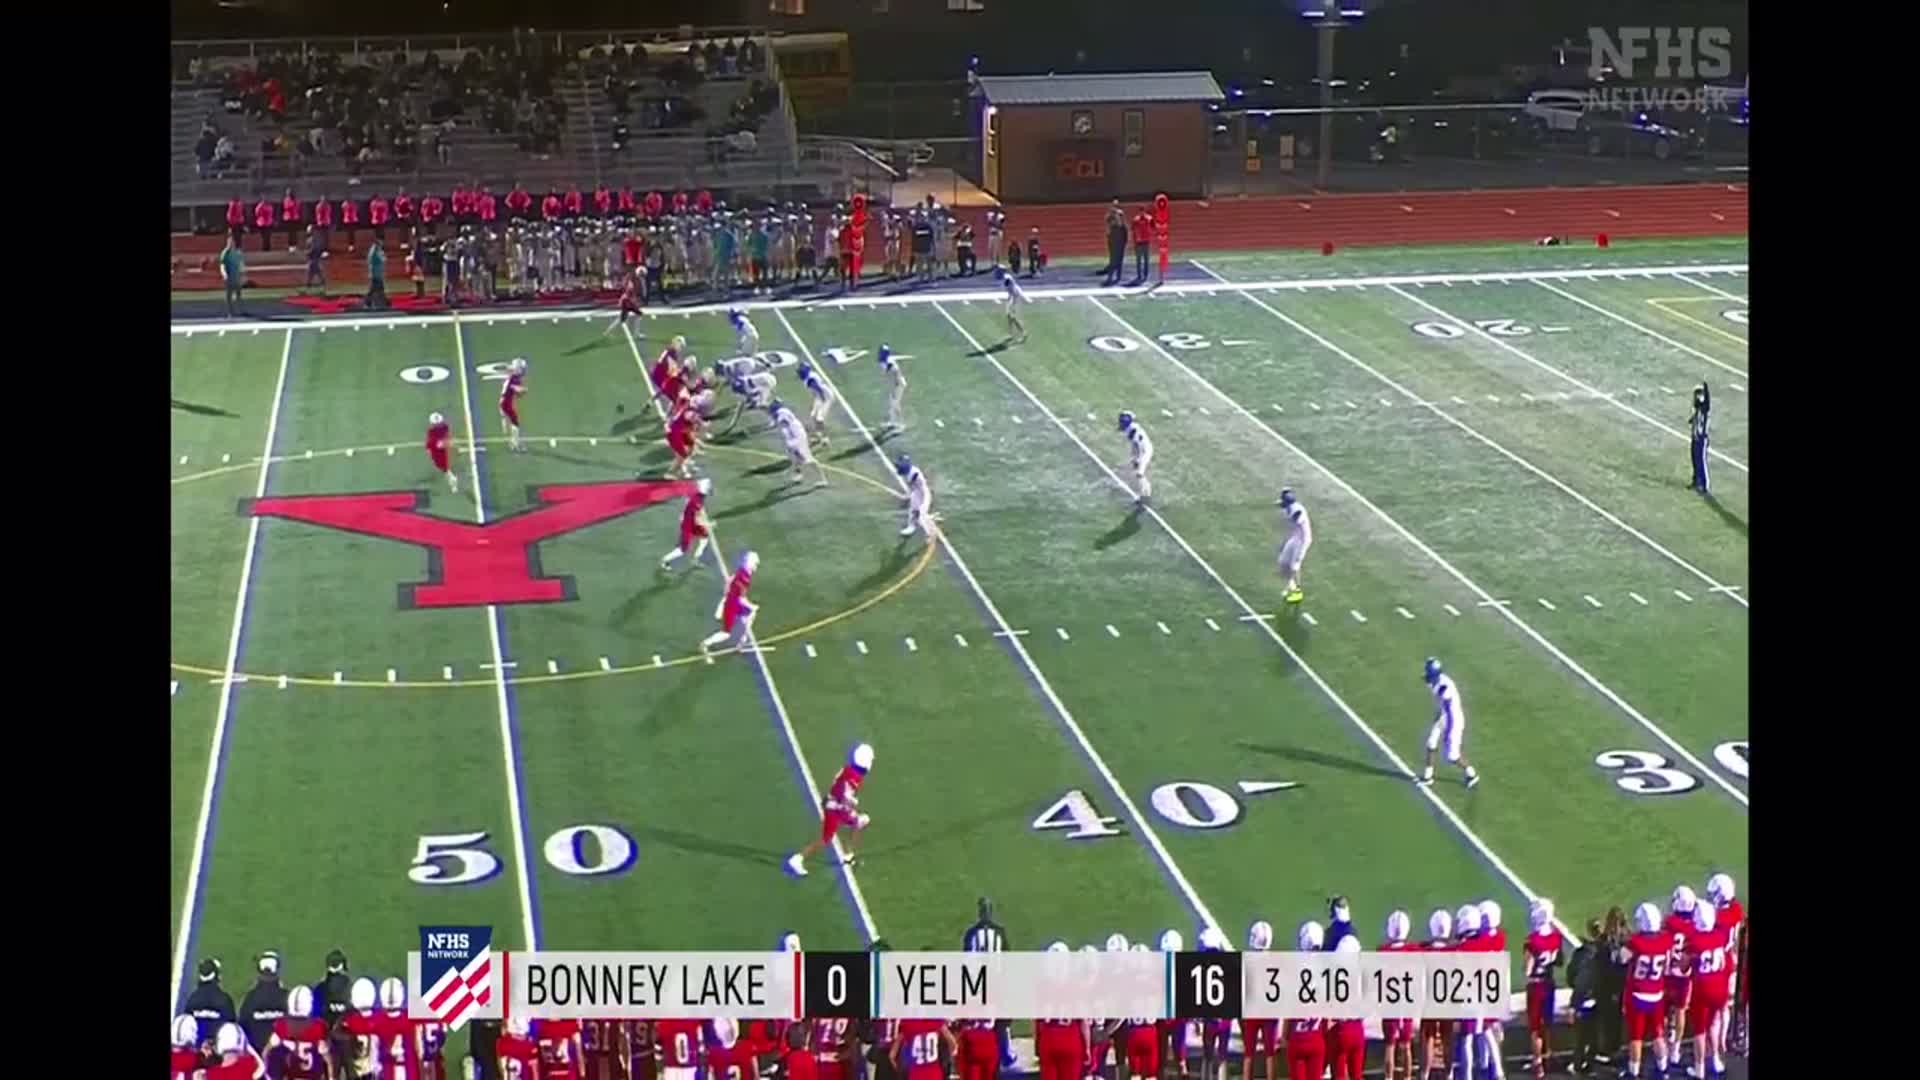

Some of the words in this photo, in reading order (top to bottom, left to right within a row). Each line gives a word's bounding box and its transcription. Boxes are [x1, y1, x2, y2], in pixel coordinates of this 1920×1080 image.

[247, 480, 705, 608] Y
[1033, 782, 1240, 838] 40
[408, 824, 634, 884] 50
[1634, 954, 1666, 980] 65
[675, 1033, 689, 1063] 0
[912, 1032, 938, 1064] 40
